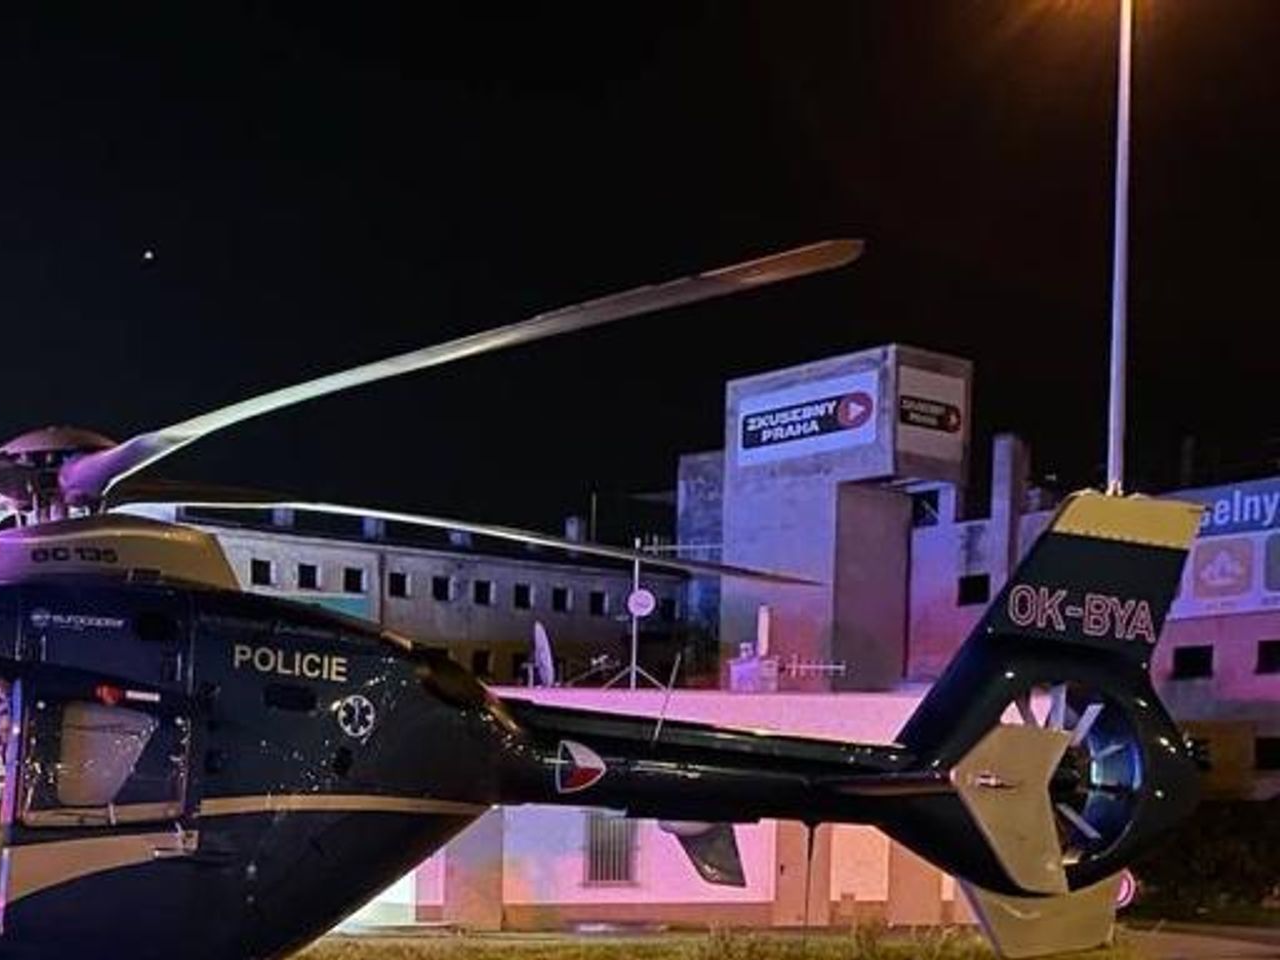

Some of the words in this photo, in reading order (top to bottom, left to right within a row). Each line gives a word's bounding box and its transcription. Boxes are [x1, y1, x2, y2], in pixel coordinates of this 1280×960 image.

[761, 419, 819, 442] PRAHA
[1008, 584, 1156, 644] OK-BYA
[234, 644, 348, 682] POLICIE
